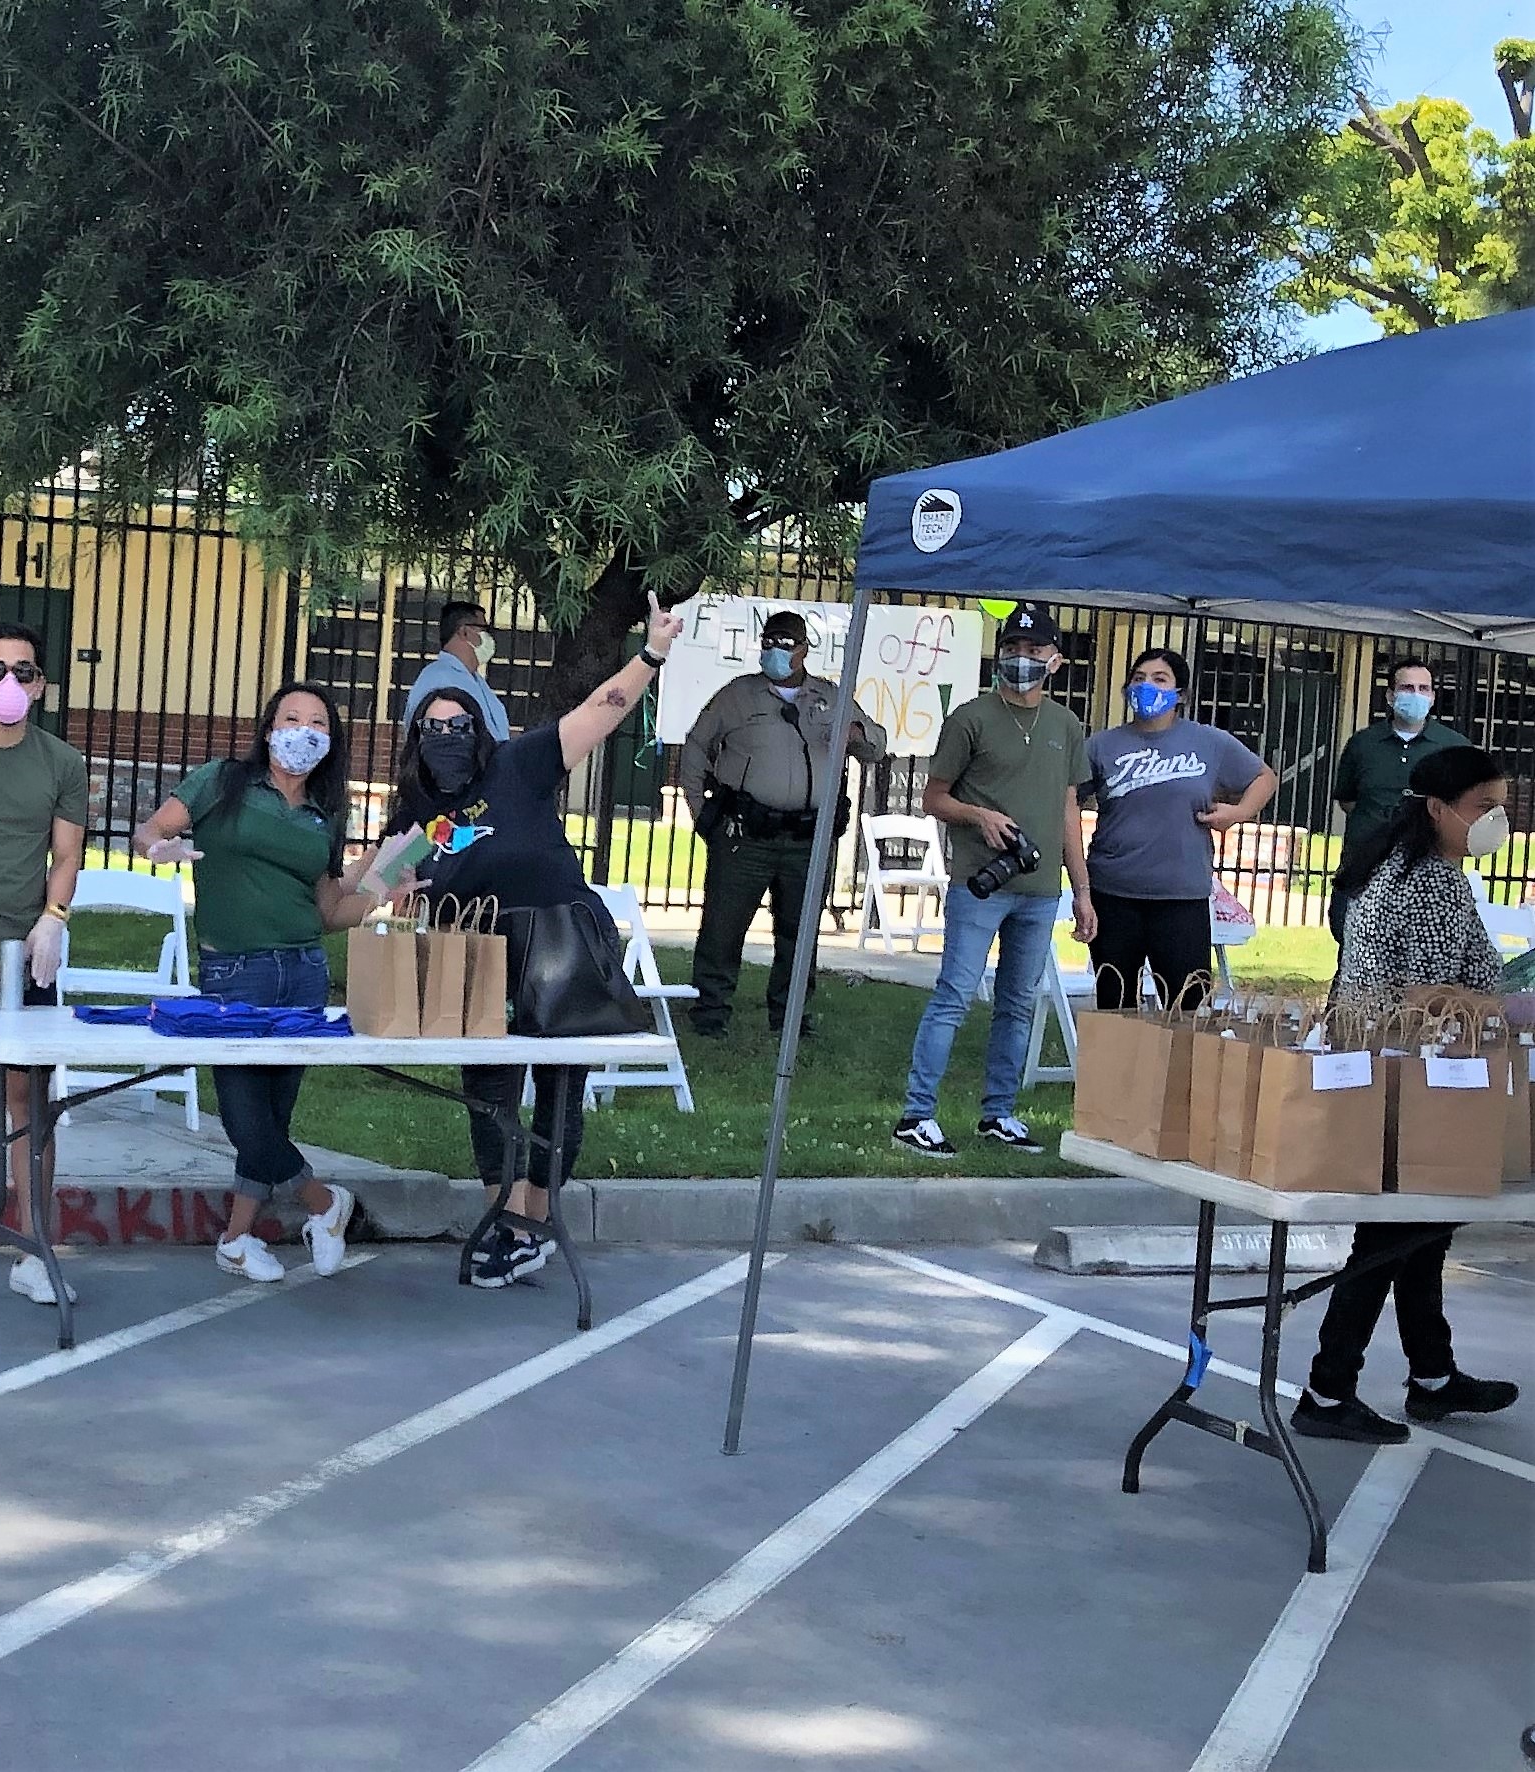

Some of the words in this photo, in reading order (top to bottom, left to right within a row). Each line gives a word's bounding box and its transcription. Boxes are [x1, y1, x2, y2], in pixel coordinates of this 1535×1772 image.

[693, 603, 847, 663] FINSH
[879, 614, 955, 676] off
[1108, 748, 1206, 788] Titans
